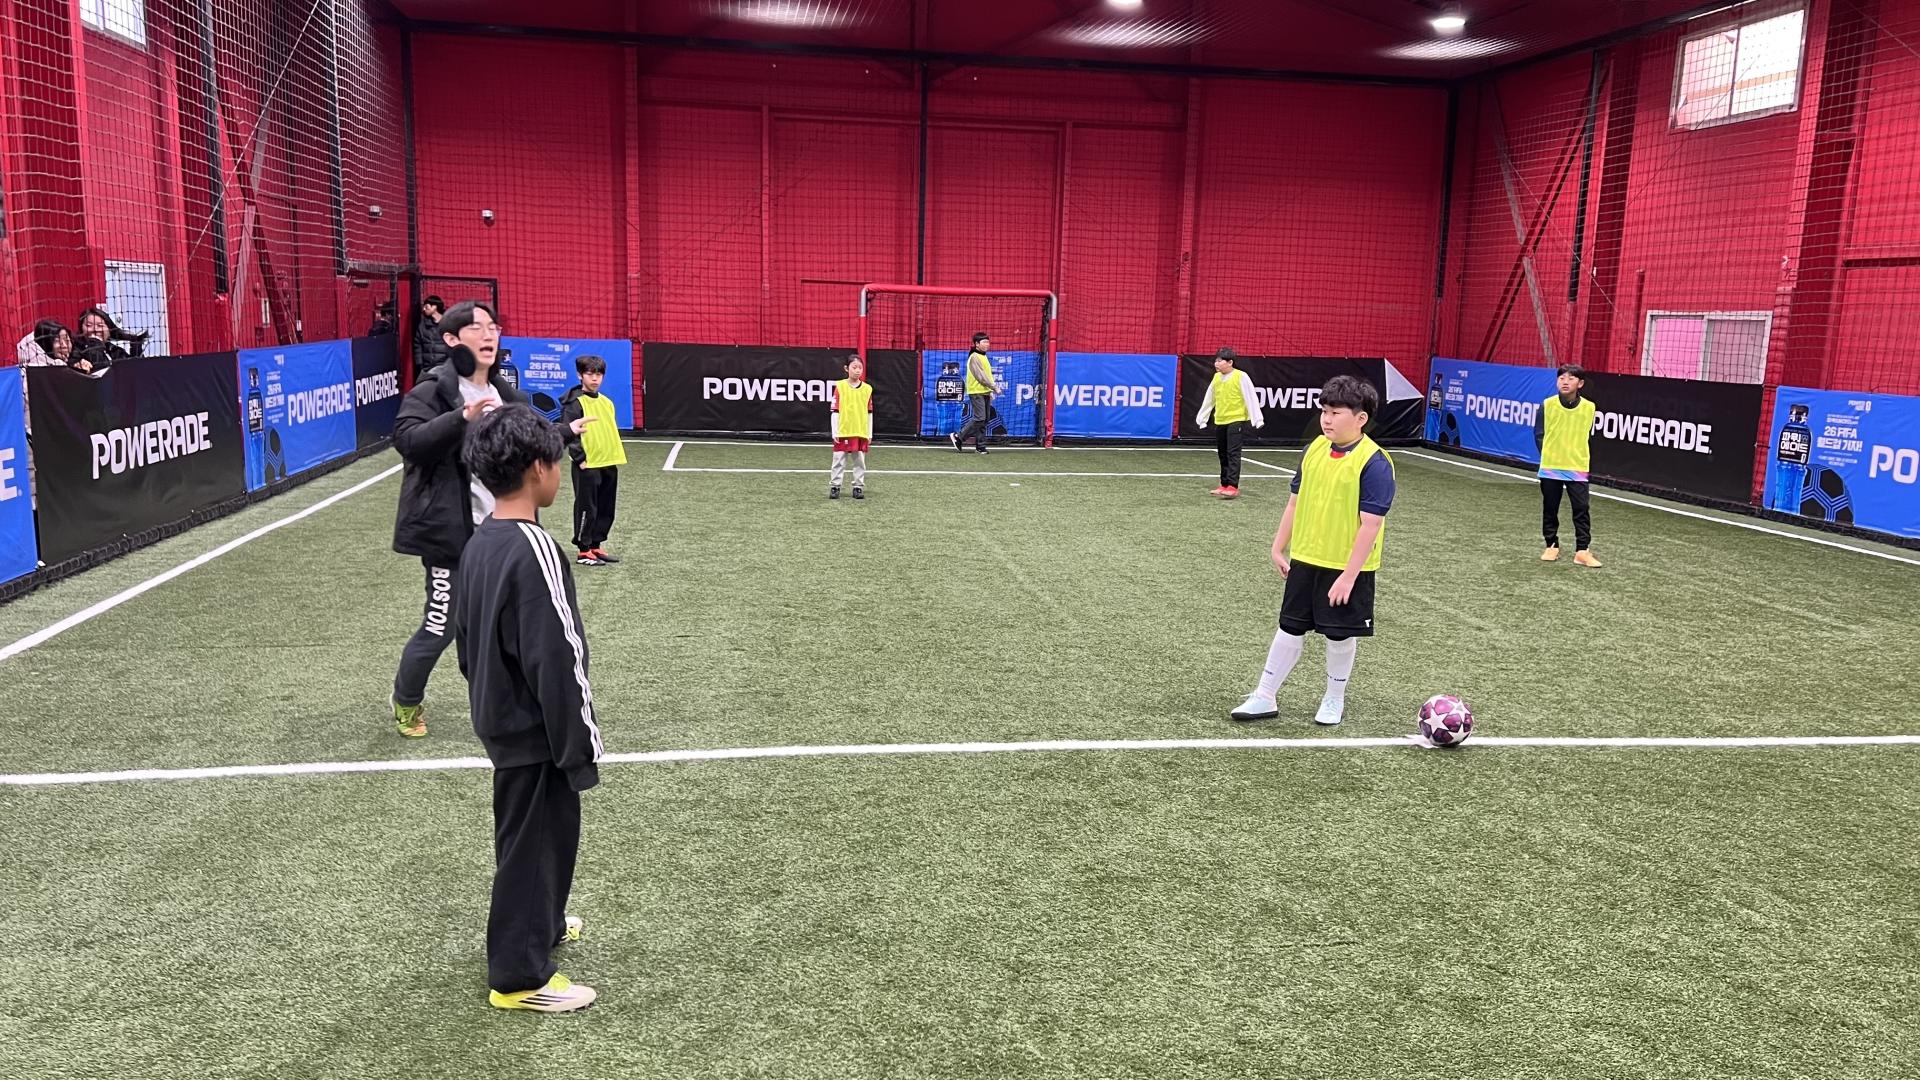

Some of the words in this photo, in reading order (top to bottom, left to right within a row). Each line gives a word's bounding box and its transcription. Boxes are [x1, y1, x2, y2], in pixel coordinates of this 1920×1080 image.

[287, 382, 352, 427] POWERADE
[355, 370, 399, 407] POWERADE
[90, 411, 211, 480] POWERADE
[1591, 410, 1712, 454] POWERADE
[1824, 426, 1837, 437] 26
[1837, 427, 1857, 440] FIFA
[425, 566, 451, 636] BOSTON
